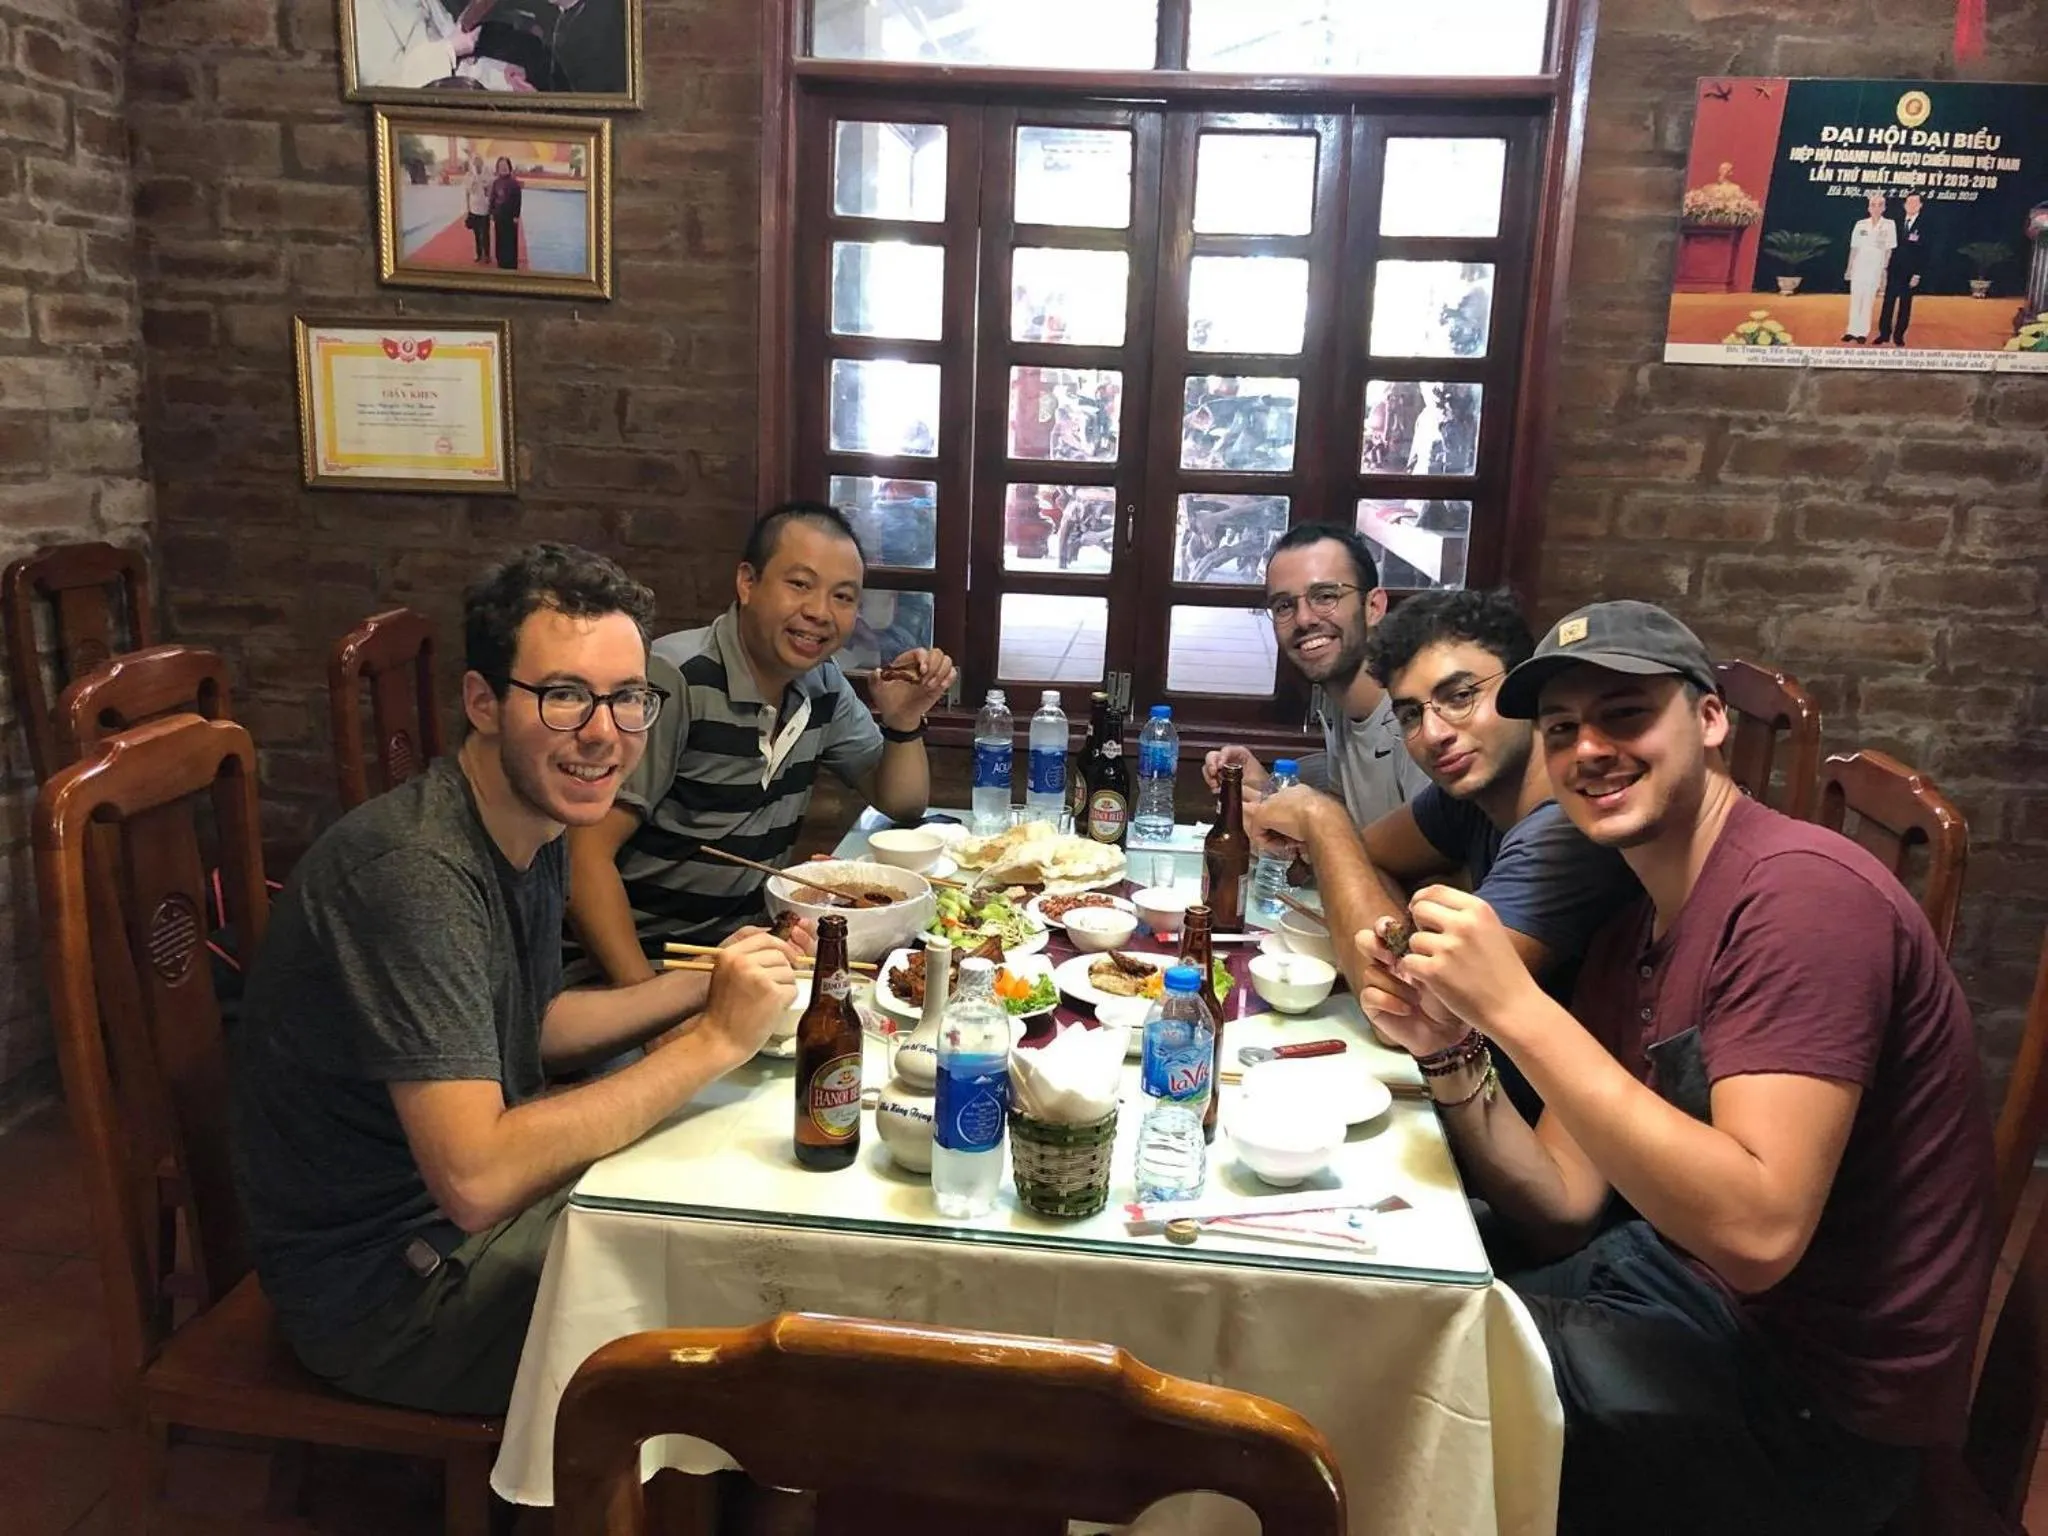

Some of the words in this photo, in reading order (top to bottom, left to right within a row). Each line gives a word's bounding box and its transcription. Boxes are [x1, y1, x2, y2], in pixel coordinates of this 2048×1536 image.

[1821, 126, 1864, 147] ĐẠI
[1868, 125, 1907, 150] HỘI
[1911, 130, 1950, 151] ĐẠI
[1953, 127, 2001, 151] BIỂU
[815, 1088, 848, 1107] HANOI
